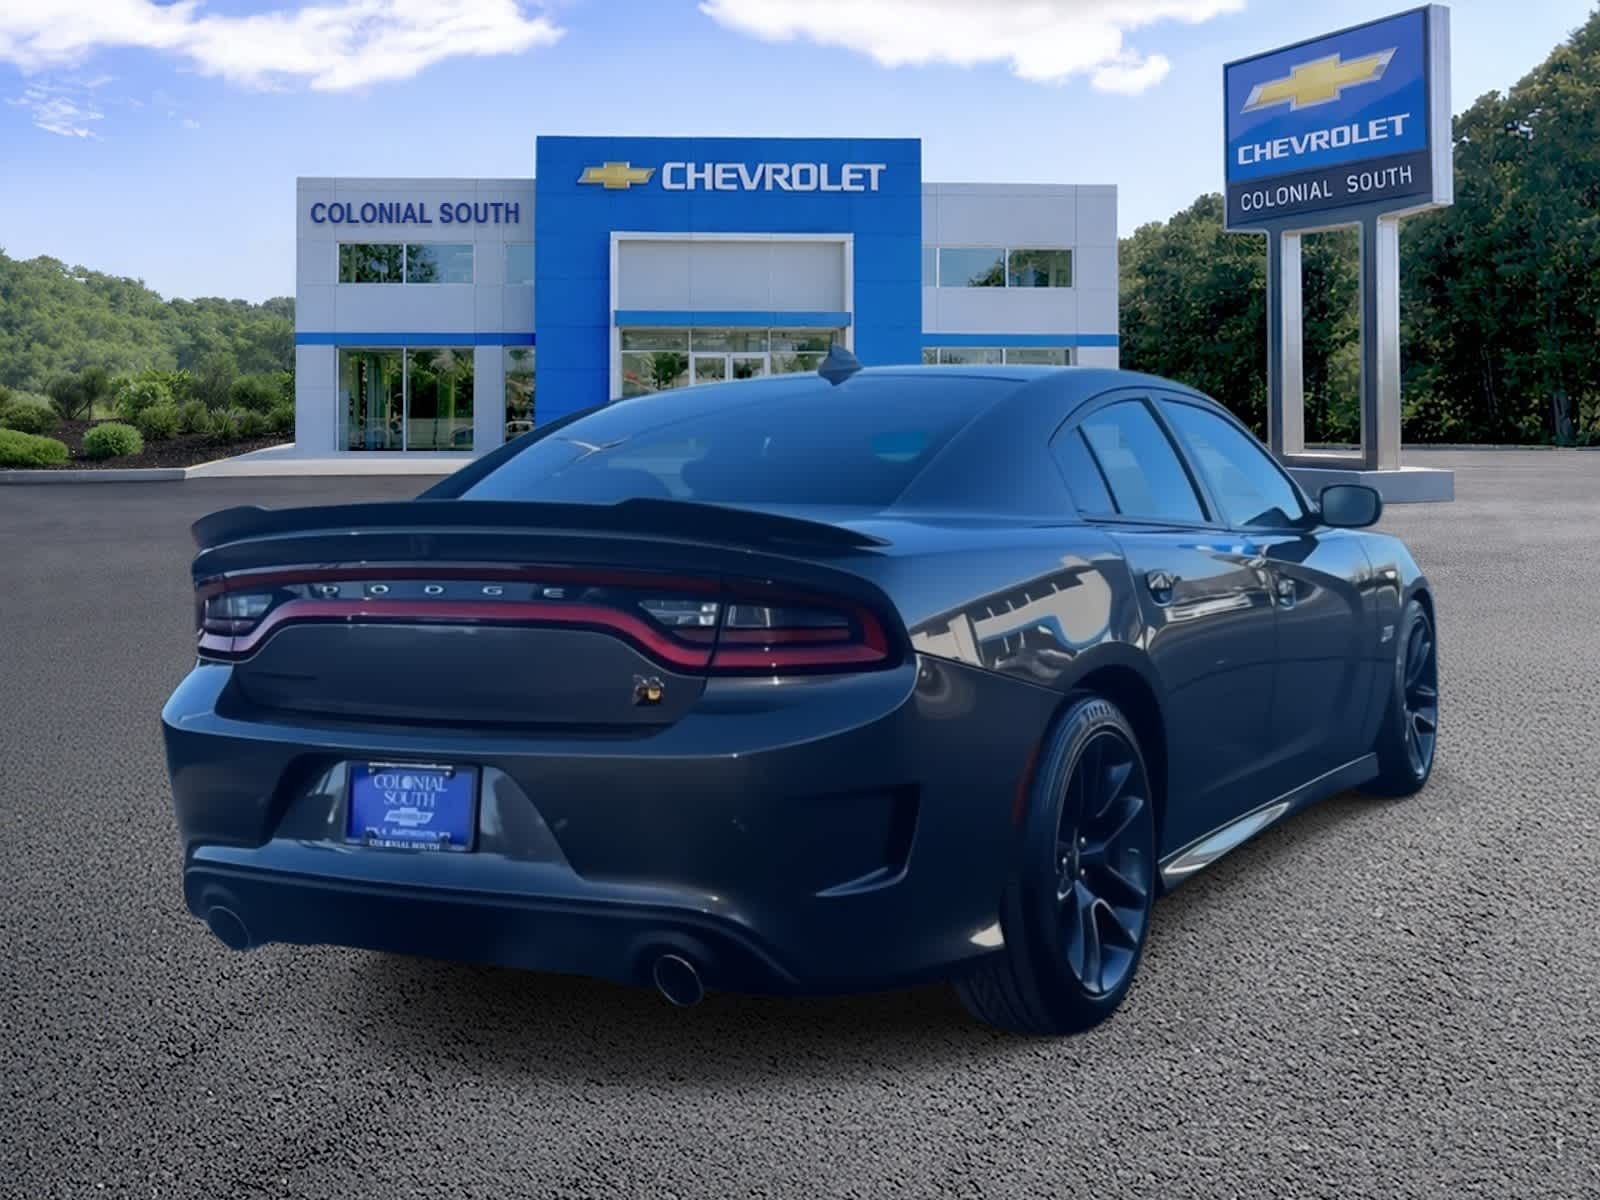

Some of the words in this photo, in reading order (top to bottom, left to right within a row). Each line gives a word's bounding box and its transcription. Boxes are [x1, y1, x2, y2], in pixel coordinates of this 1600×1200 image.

[1238, 113, 1410, 165] CHEVROLET
[662, 162, 886, 191] CHEVROLET
[1241, 180, 1333, 211] COLONIAL
[1347, 165, 1412, 193] SOUTH
[310, 202, 432, 225] COLONIAL
[440, 202, 520, 225] SOUTH
[322, 584, 564, 598] DODGE
[373, 774, 448, 792] COLONIAL
[384, 790, 435, 808] SOUTH
